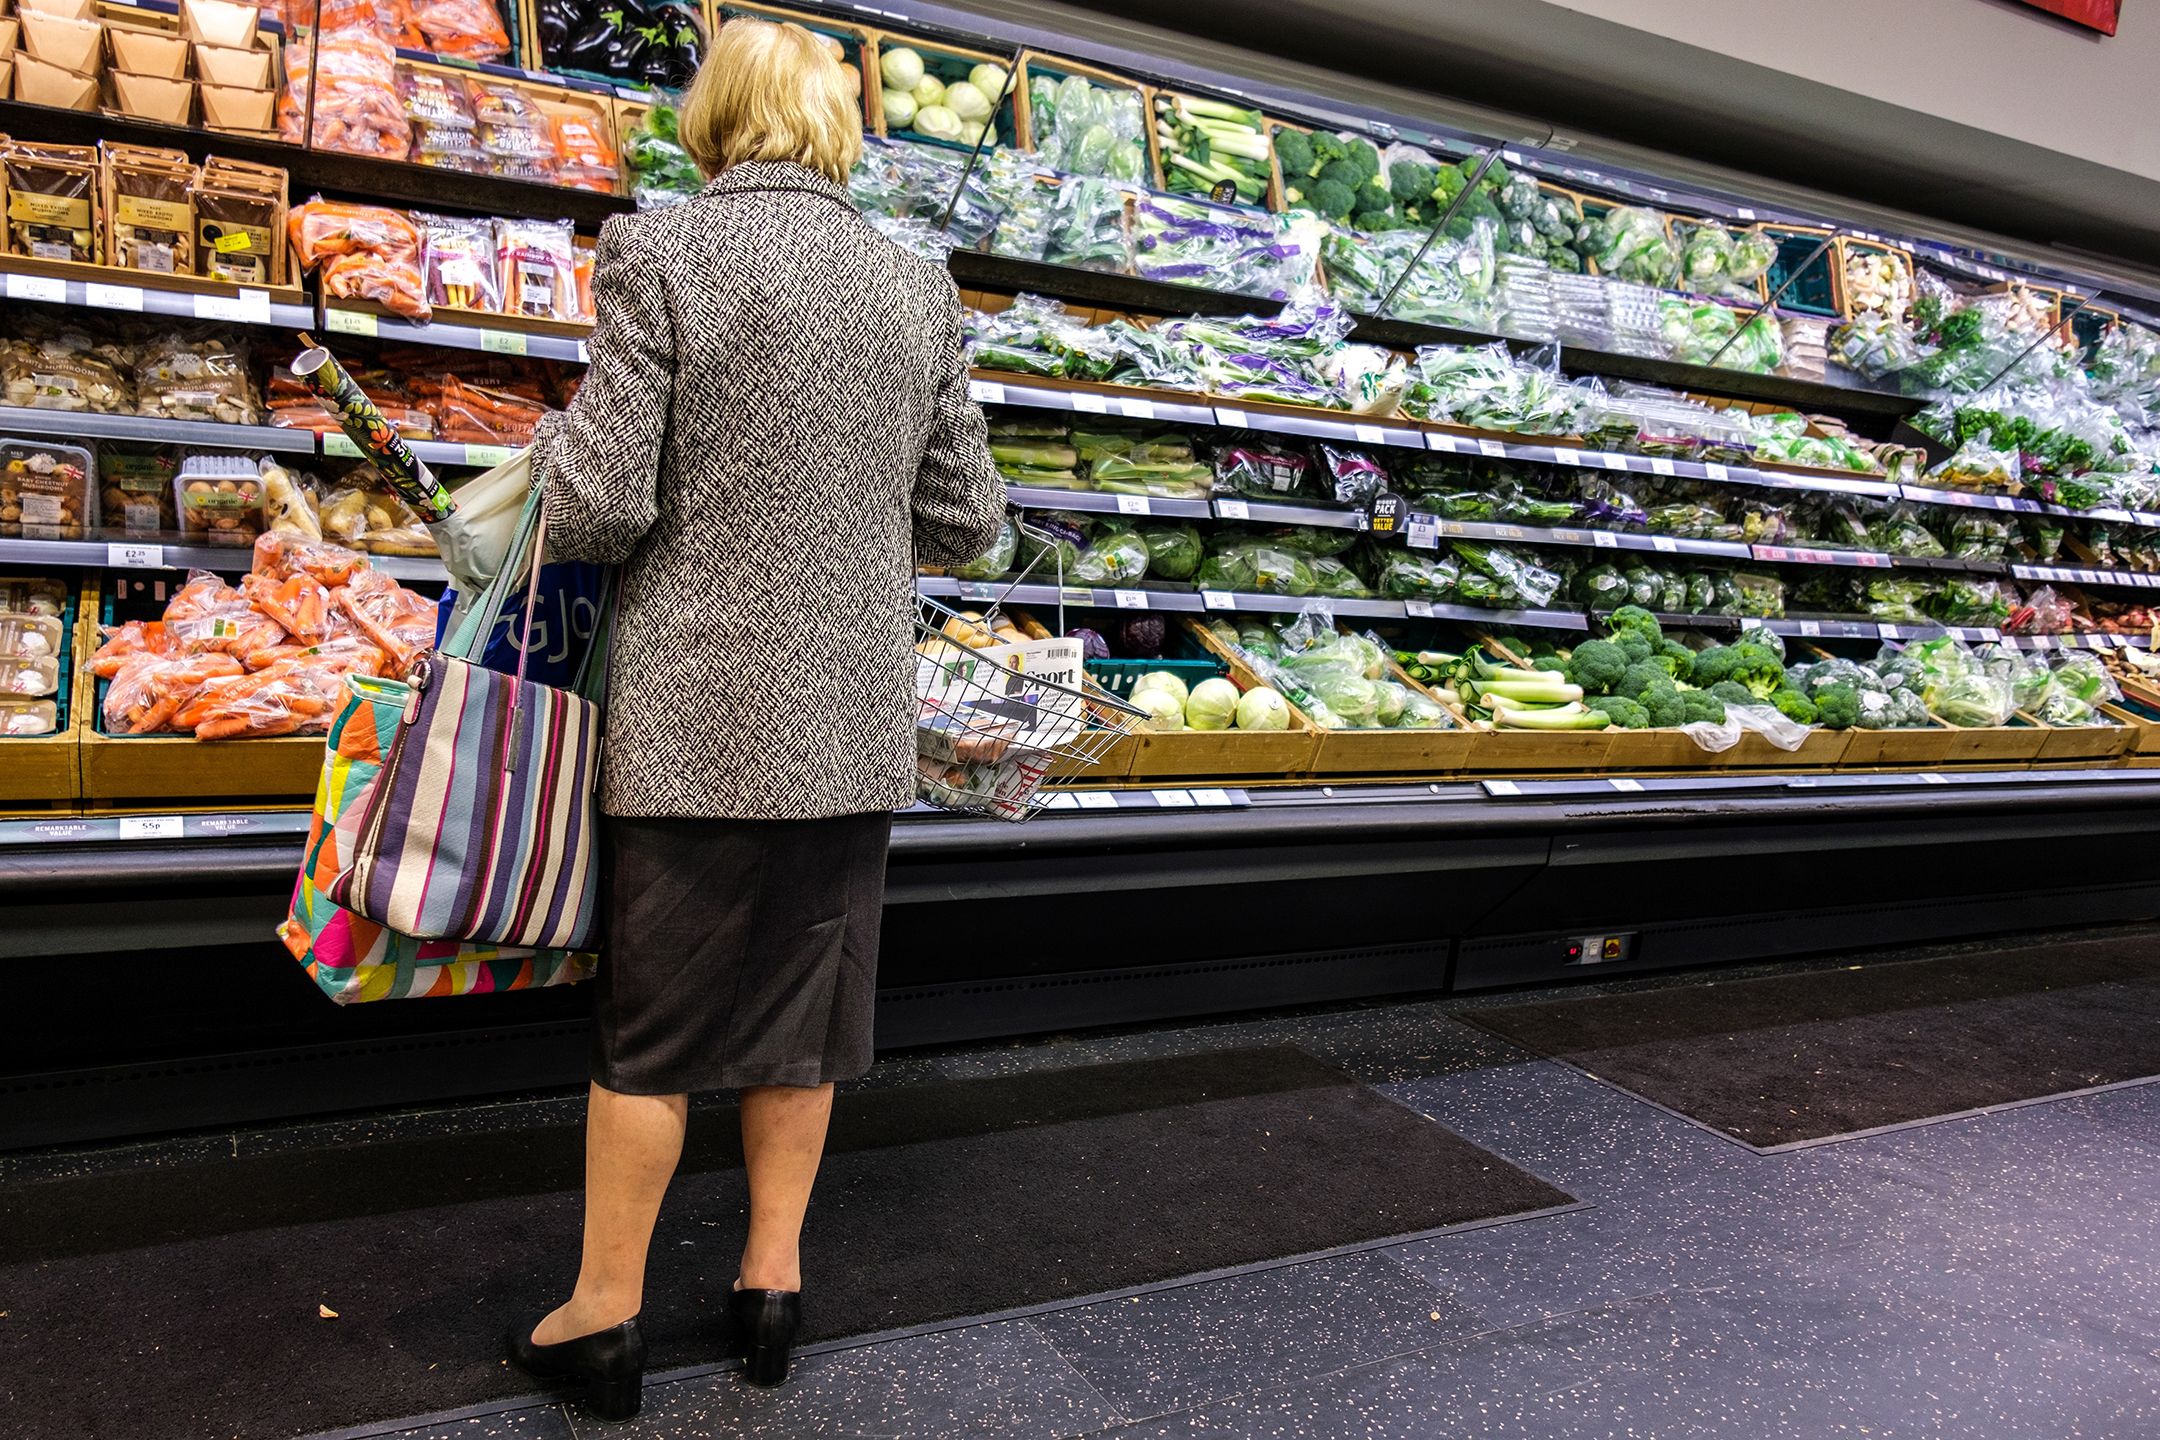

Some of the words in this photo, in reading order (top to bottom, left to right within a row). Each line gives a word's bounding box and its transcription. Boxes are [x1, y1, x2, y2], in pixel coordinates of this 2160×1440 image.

[45, 364, 101, 378] MUSHROOMS
[1374, 504, 1396, 514] PACK
[1373, 523, 1393, 531] VALUE
[142, 822, 161, 830] 55p
